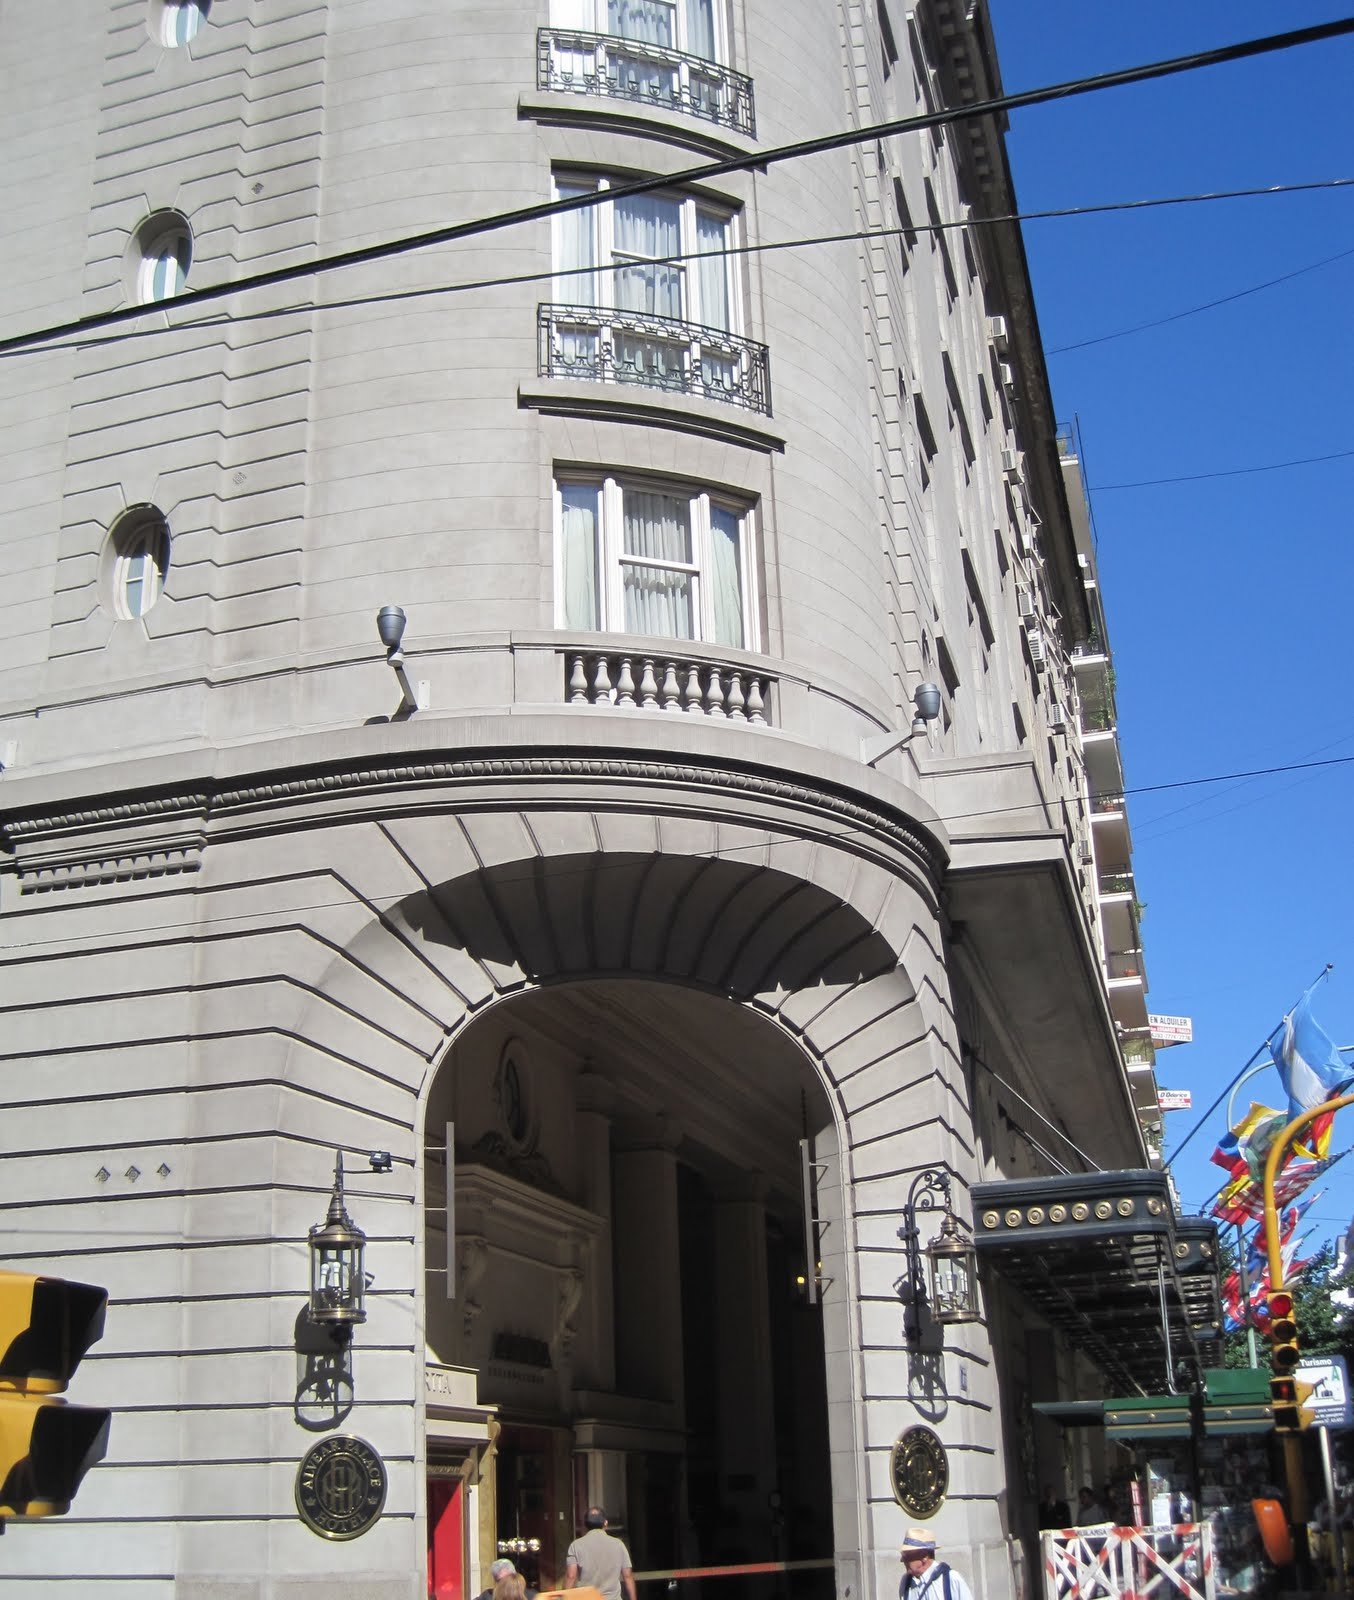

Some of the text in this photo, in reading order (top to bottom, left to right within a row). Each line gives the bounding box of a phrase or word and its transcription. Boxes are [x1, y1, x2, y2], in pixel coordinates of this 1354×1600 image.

[1149, 1016, 1188, 1026] EN ALQUILER
[1300, 1358, 1332, 1367] Turismo
[303, 1440, 339, 1490] ALVEAR
[345, 1440, 381, 1487] PALACE
[317, 1514, 367, 1530] HOTEL
